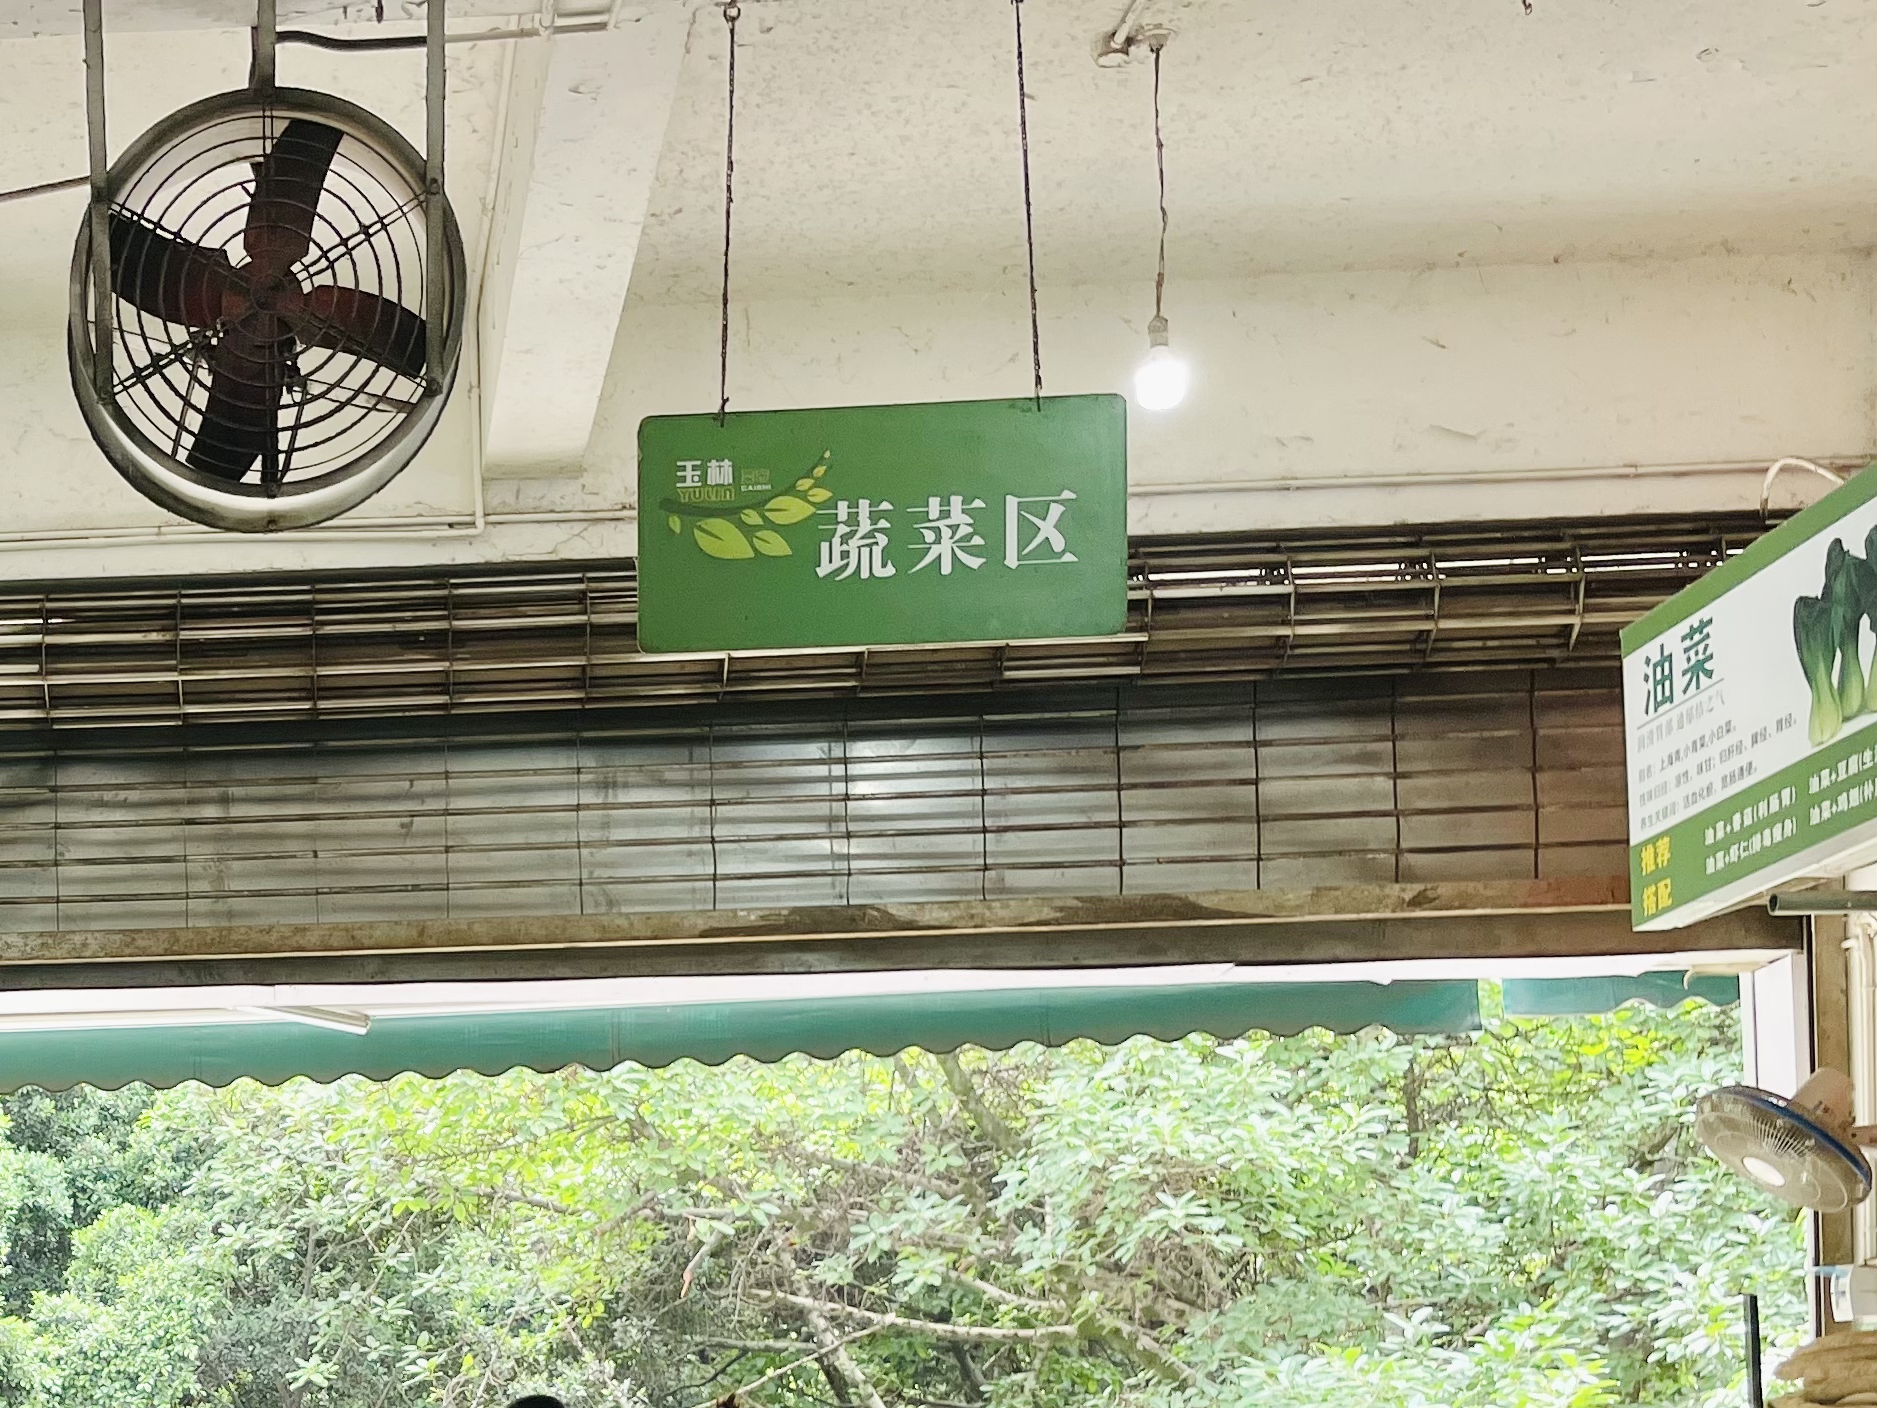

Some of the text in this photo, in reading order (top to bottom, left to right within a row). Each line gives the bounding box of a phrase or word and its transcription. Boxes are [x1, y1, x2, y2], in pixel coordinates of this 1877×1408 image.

[676, 459, 733, 487] 玉林
[815, 490, 1079, 581] 蔬菜区
[1643, 616, 1714, 715] 油菜
[1640, 835, 1671, 876] 推荐
[1642, 877, 1673, 917] 搭配
